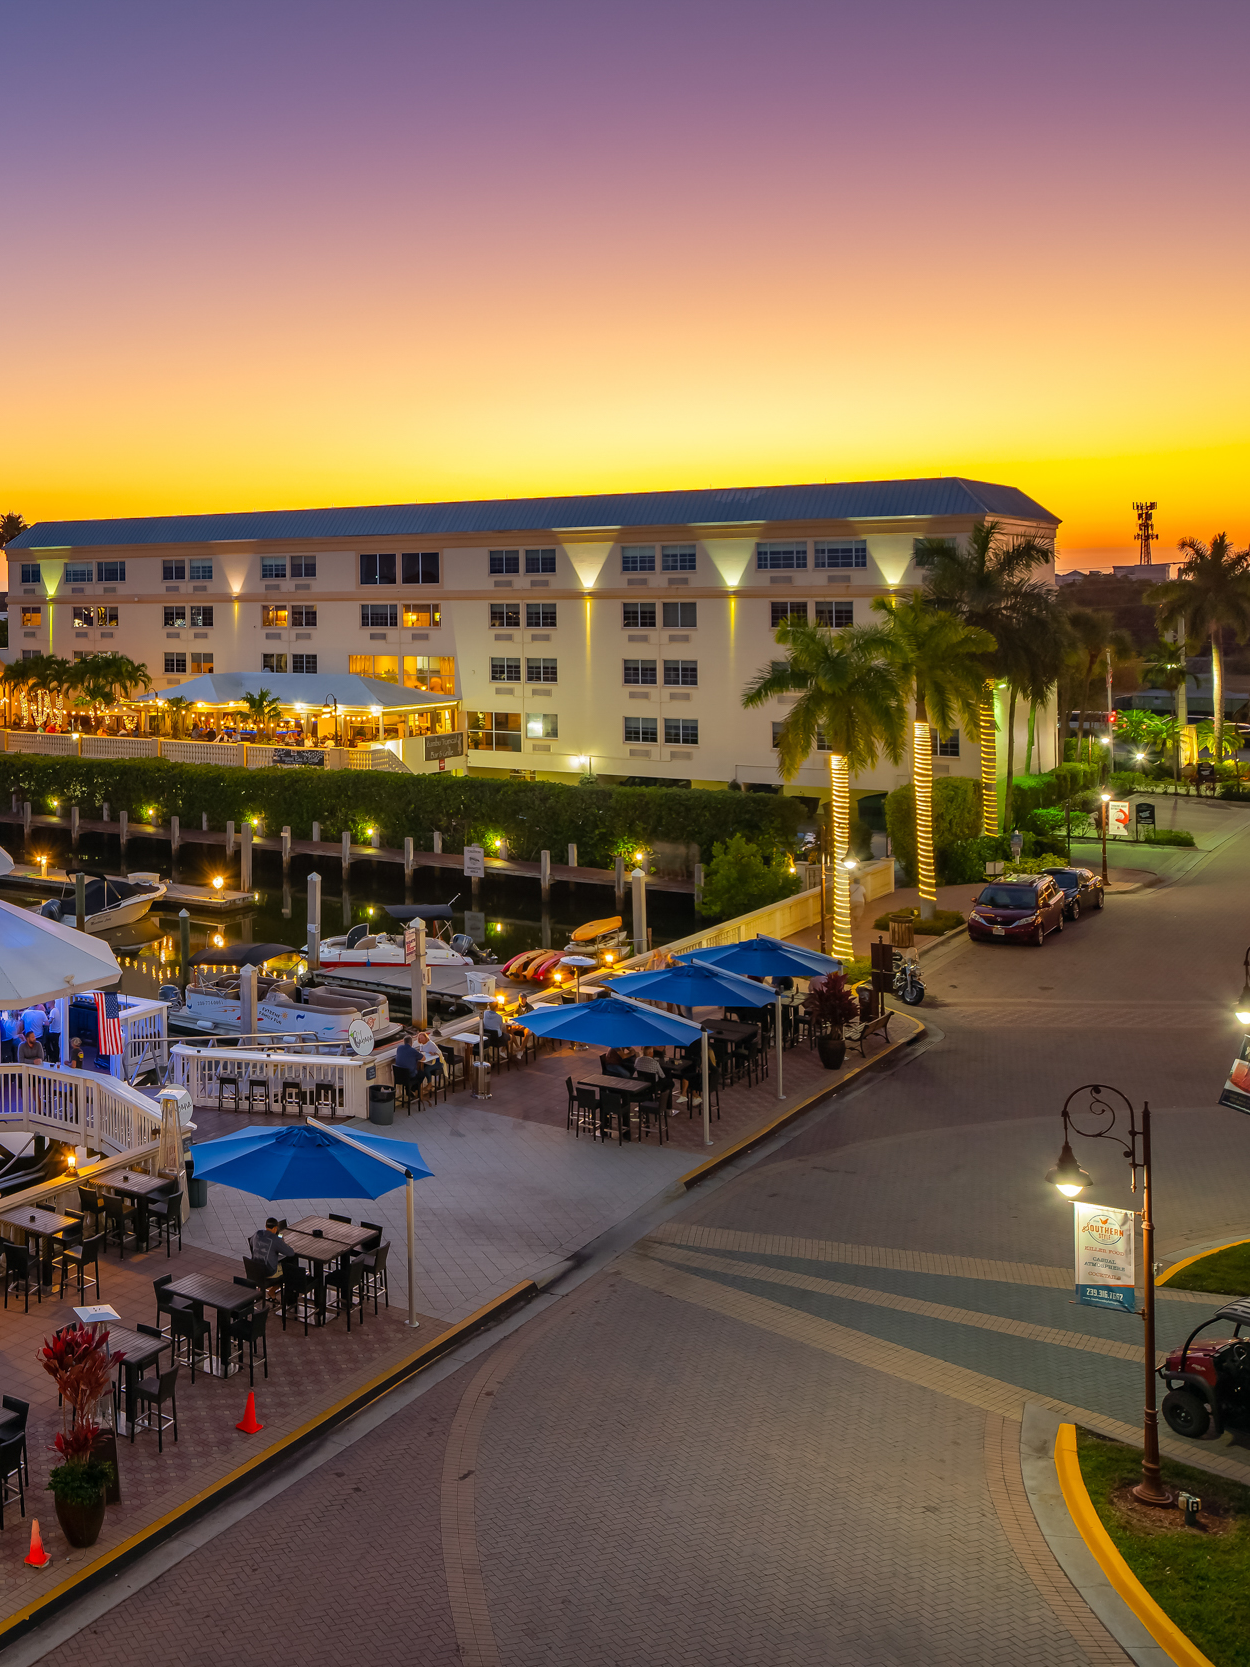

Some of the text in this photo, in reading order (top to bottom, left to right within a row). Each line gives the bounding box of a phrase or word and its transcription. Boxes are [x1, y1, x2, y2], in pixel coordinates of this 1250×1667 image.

[1108, 1249, 1125, 1257] FOOD
[1092, 1256, 1117, 1265] CASUAL
[1084, 1261, 1126, 1272] ATMOSPHERE
[1087, 1271, 1122, 1280] COCKTAILS
